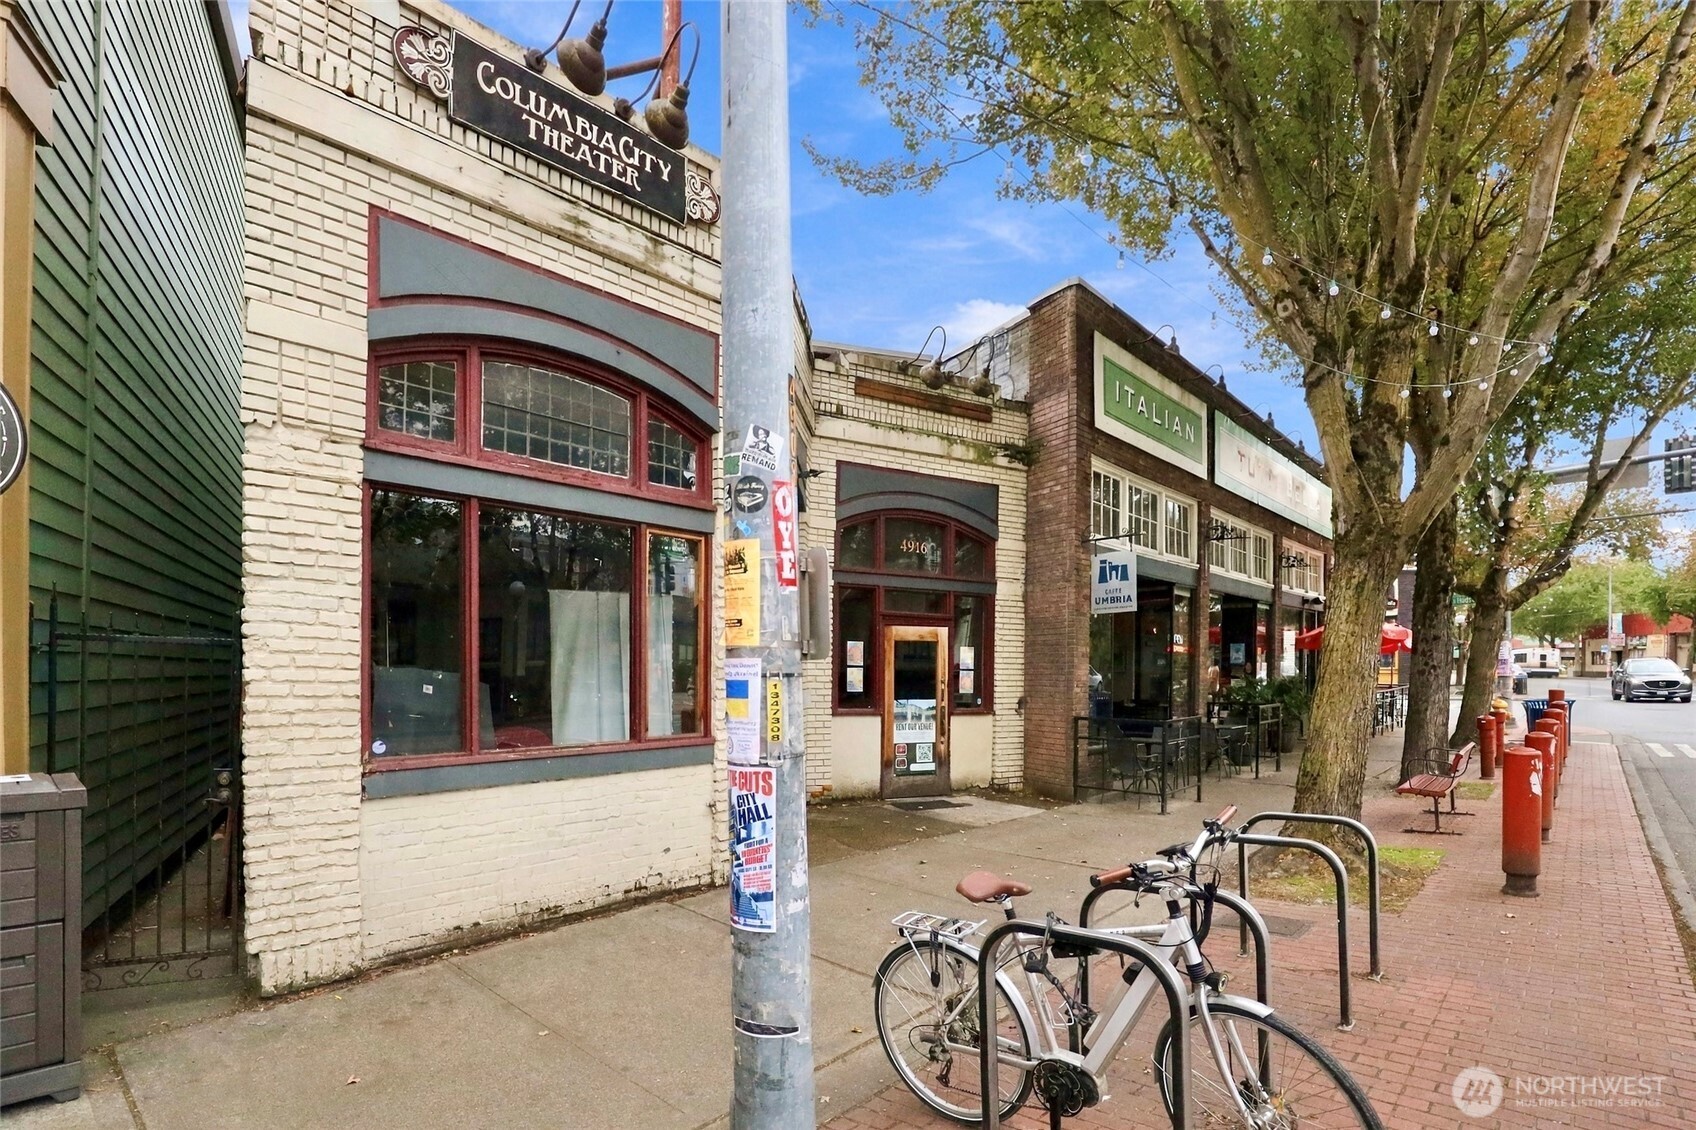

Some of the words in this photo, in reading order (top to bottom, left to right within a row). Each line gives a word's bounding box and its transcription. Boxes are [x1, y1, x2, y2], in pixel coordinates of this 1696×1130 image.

[521, 113, 642, 192] THEATER
[1115, 380, 1197, 444] ITALIAN
[741, 452, 777, 471] REMAND
[900, 539, 928, 554] 4916
[1094, 594, 1133, 605] UMBRIA
[770, 683, 780, 742] 1347308
[895, 722, 907, 731] RENT
[907, 722, 917, 731] OUR
[738, 770, 773, 796] CUTS
[736, 792, 757, 808] CITY
[738, 802, 773, 826] HALL
